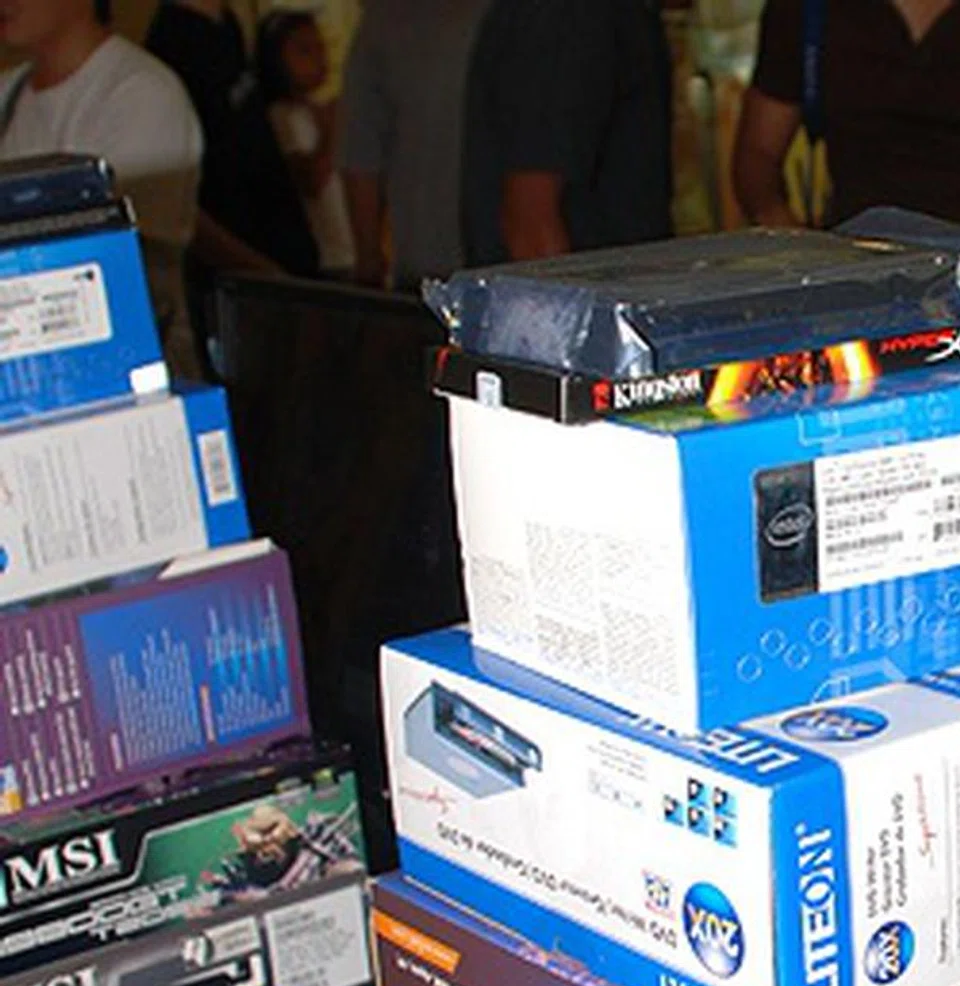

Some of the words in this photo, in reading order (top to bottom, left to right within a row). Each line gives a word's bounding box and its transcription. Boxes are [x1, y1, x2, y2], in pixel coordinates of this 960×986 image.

[611, 371, 702, 413] Kingston
[4, 828, 117, 895] MSI
[689, 903, 741, 958] 20X
